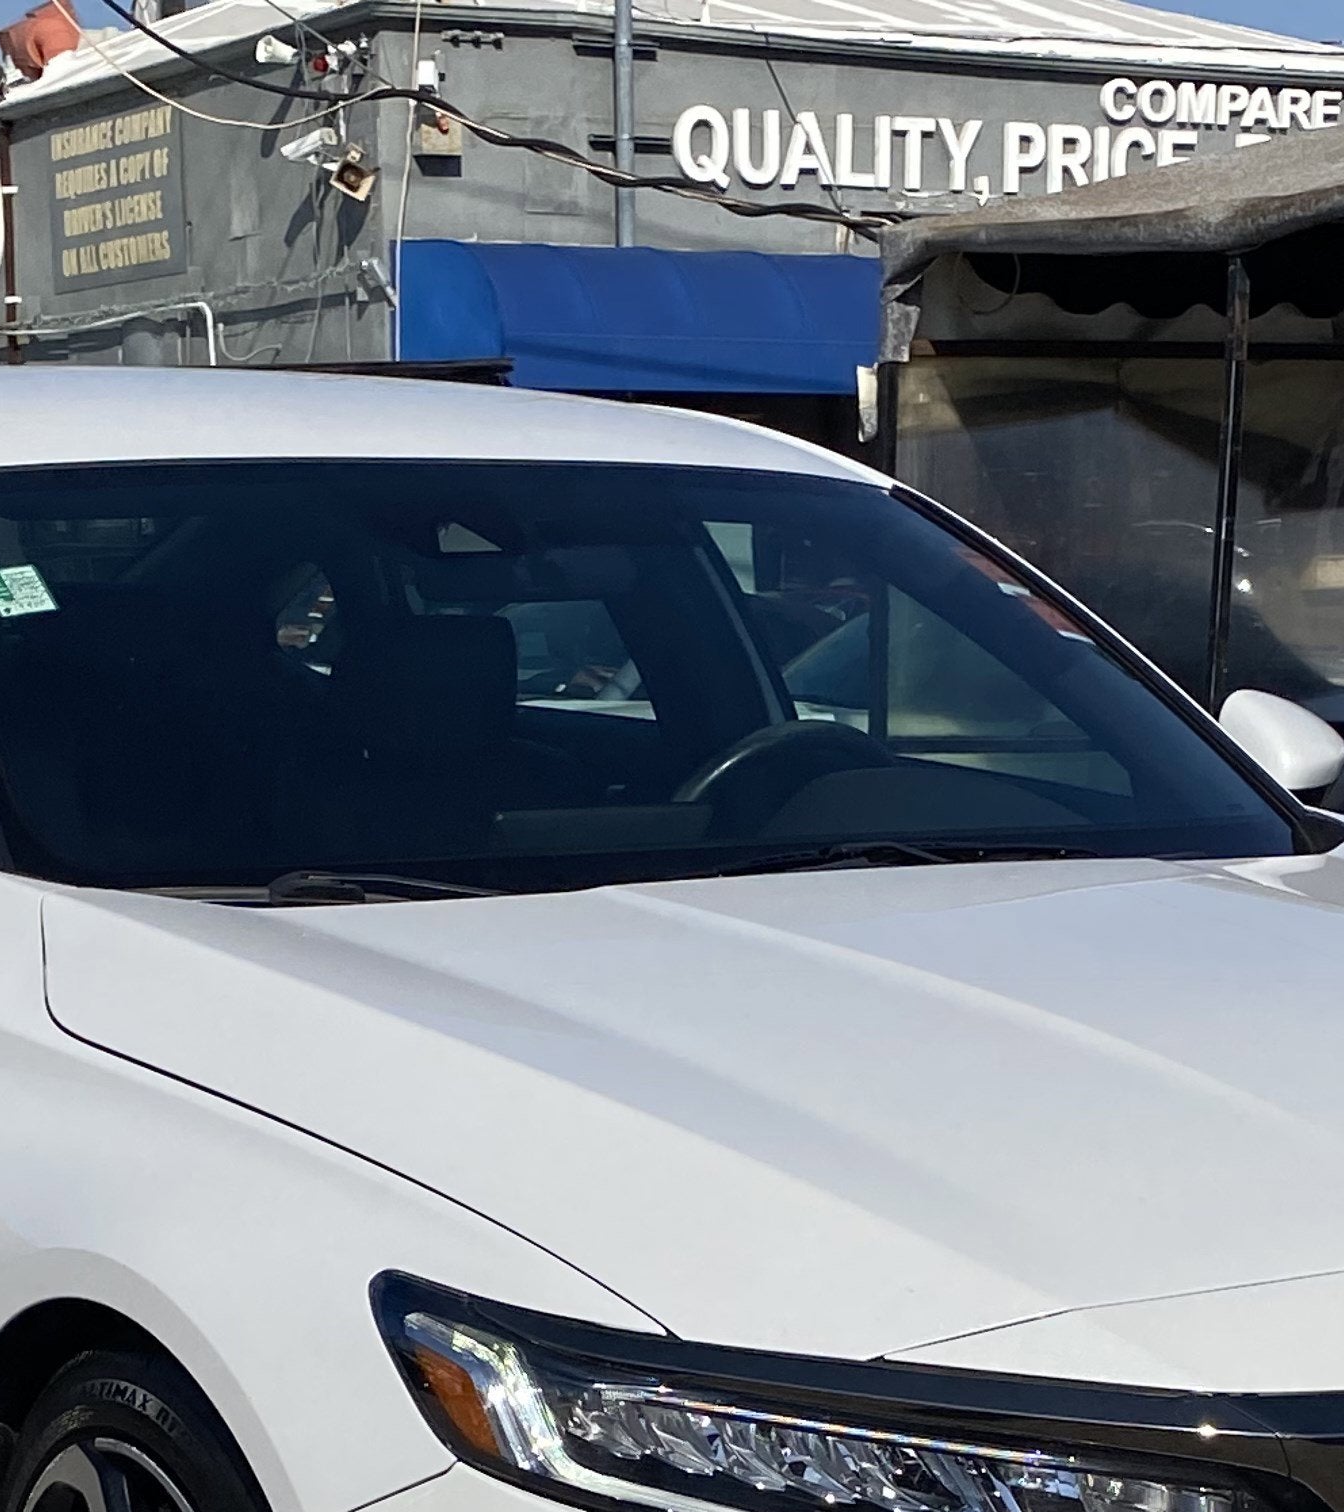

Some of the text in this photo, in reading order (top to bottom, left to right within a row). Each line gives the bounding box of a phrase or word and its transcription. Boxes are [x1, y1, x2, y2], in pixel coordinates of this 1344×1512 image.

[1100, 78, 1343, 130] COMPARE
[51, 105, 172, 161] INSURANCE COMPANY
[672, 105, 990, 207] QUALITY,
[55, 147, 169, 199] REQUIRES A COPY OF
[63, 190, 163, 238] DRIVER'S LICENSE
[62, 230, 171, 277] ON ALL CUSTOMERS
